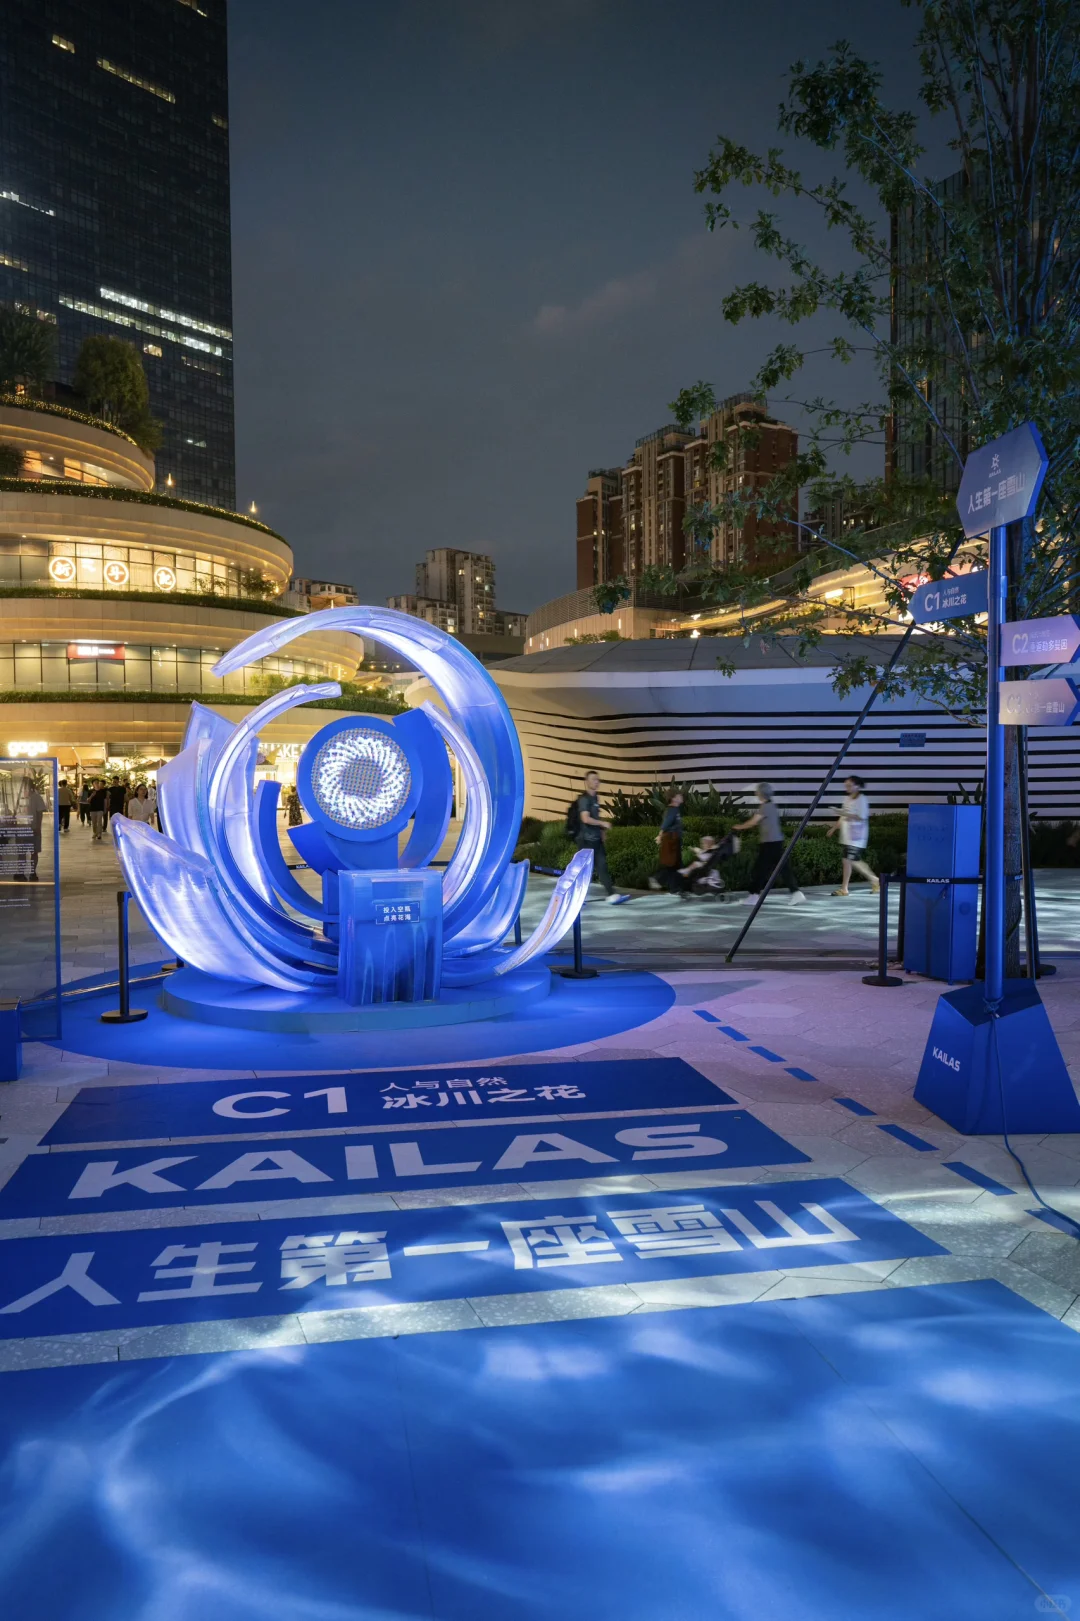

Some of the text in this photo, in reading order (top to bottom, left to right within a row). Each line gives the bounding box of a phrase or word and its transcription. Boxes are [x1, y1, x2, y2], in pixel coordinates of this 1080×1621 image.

[968, 472, 1026, 514] 人生第一座雪山
[924, 592, 940, 612] C1
[942, 594, 967, 608] 冰川之花
[1012, 633, 1029, 654] C2
[383, 905, 412, 914] 投入空瓶
[383, 913, 412, 922] 点亮花海
[932, 1046, 961, 1072] KAILAS
[380, 1076, 508, 1092] 人与自然
[212, 1086, 348, 1119] C1
[381, 1084, 586, 1109] 冰川之花
[68, 1124, 728, 1200] KAILAS
[0, 1200, 861, 1314] 人生第一座雪山
